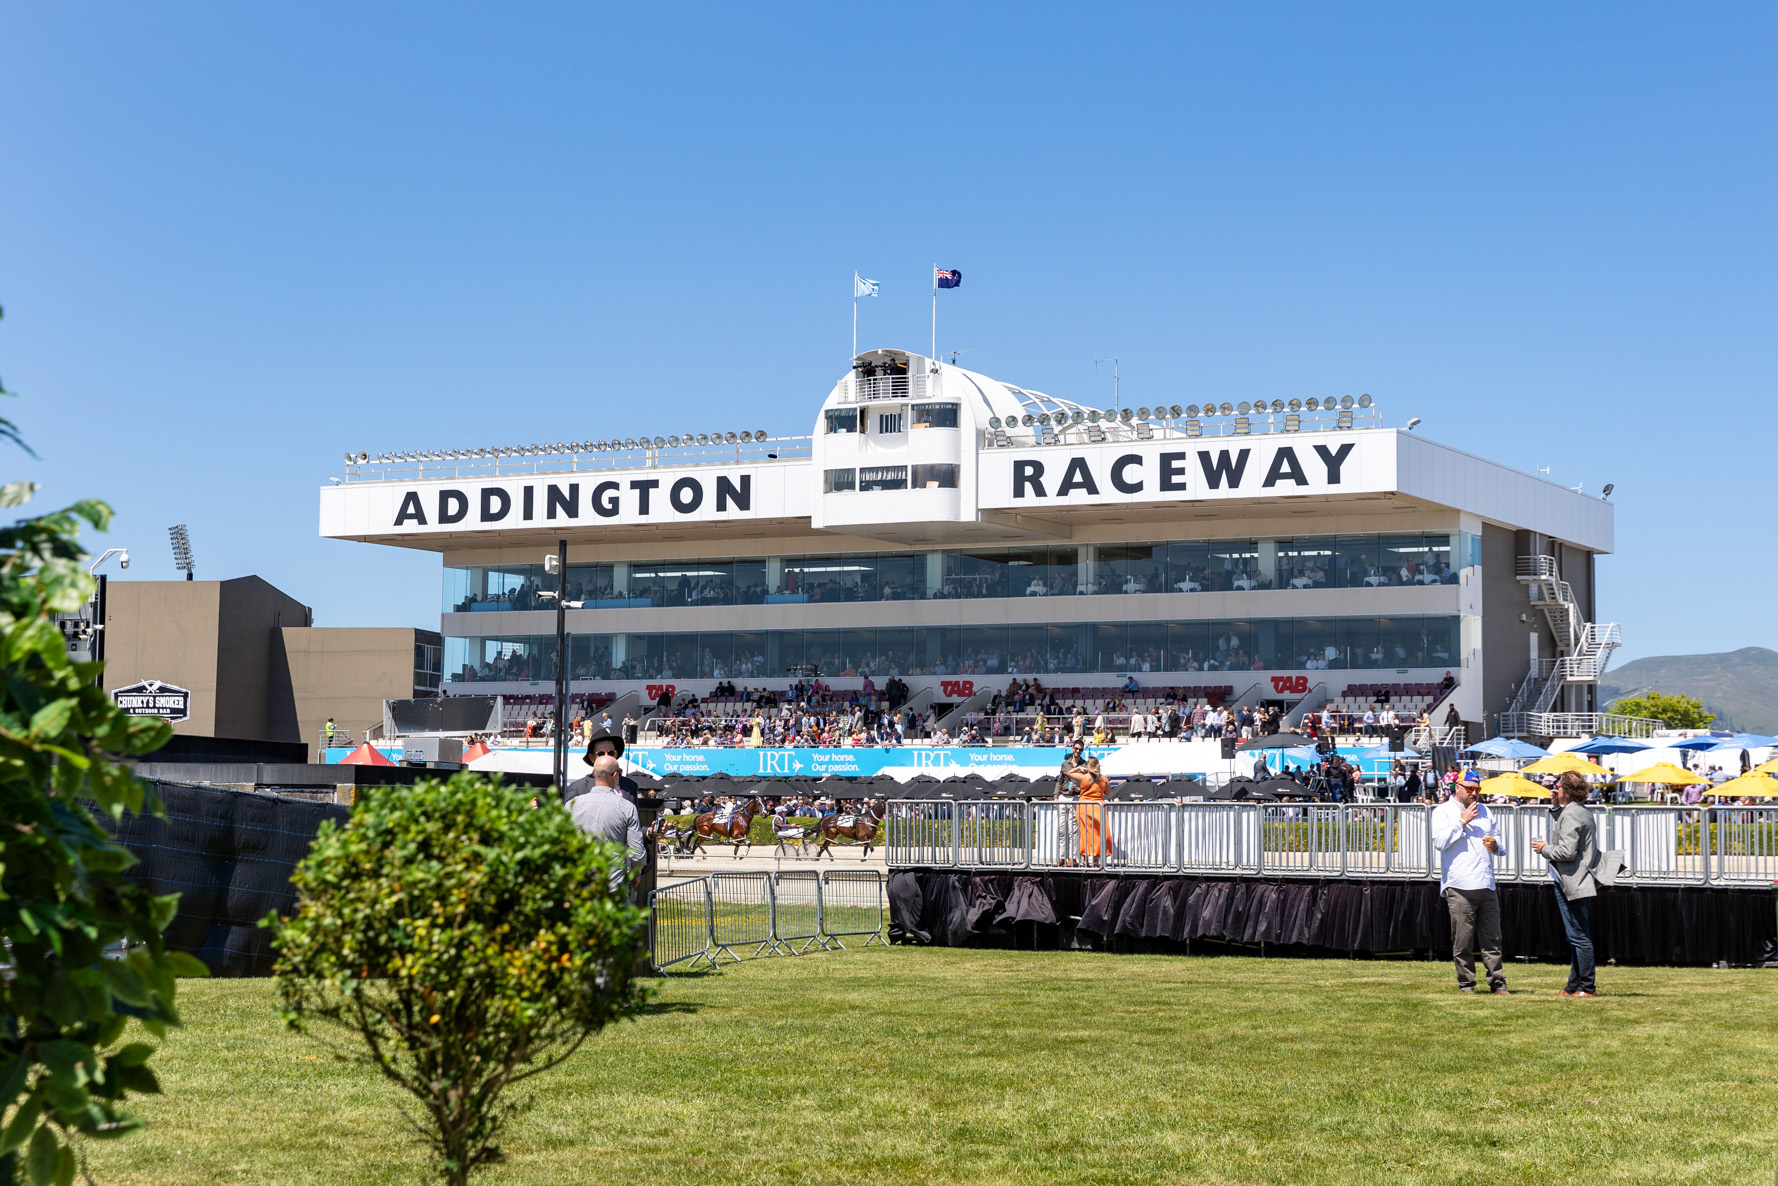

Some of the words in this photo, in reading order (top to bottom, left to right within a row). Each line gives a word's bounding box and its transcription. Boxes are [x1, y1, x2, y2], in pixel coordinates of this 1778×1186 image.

[393, 474, 752, 527] ADDINGTON
[1013, 443, 1356, 498] RACEWAY
[940, 680, 975, 698] TAB
[1270, 676, 1309, 694] TAB
[117, 696, 154, 709] CHUNKY'S
[155, 696, 184, 709] SMOKER
[664, 753, 681, 762] Your
[683, 753, 706, 762] horse.
[758, 751, 795, 773] IRT
[811, 753, 830, 762] Your
[832, 753, 856, 762] horse.
[969, 753, 988, 762] Your
[990, 753, 1015, 762] horse.
[680, 763, 710, 772] passion.
[811, 763, 826, 772] Our
[828, 763, 860, 773] passion.
